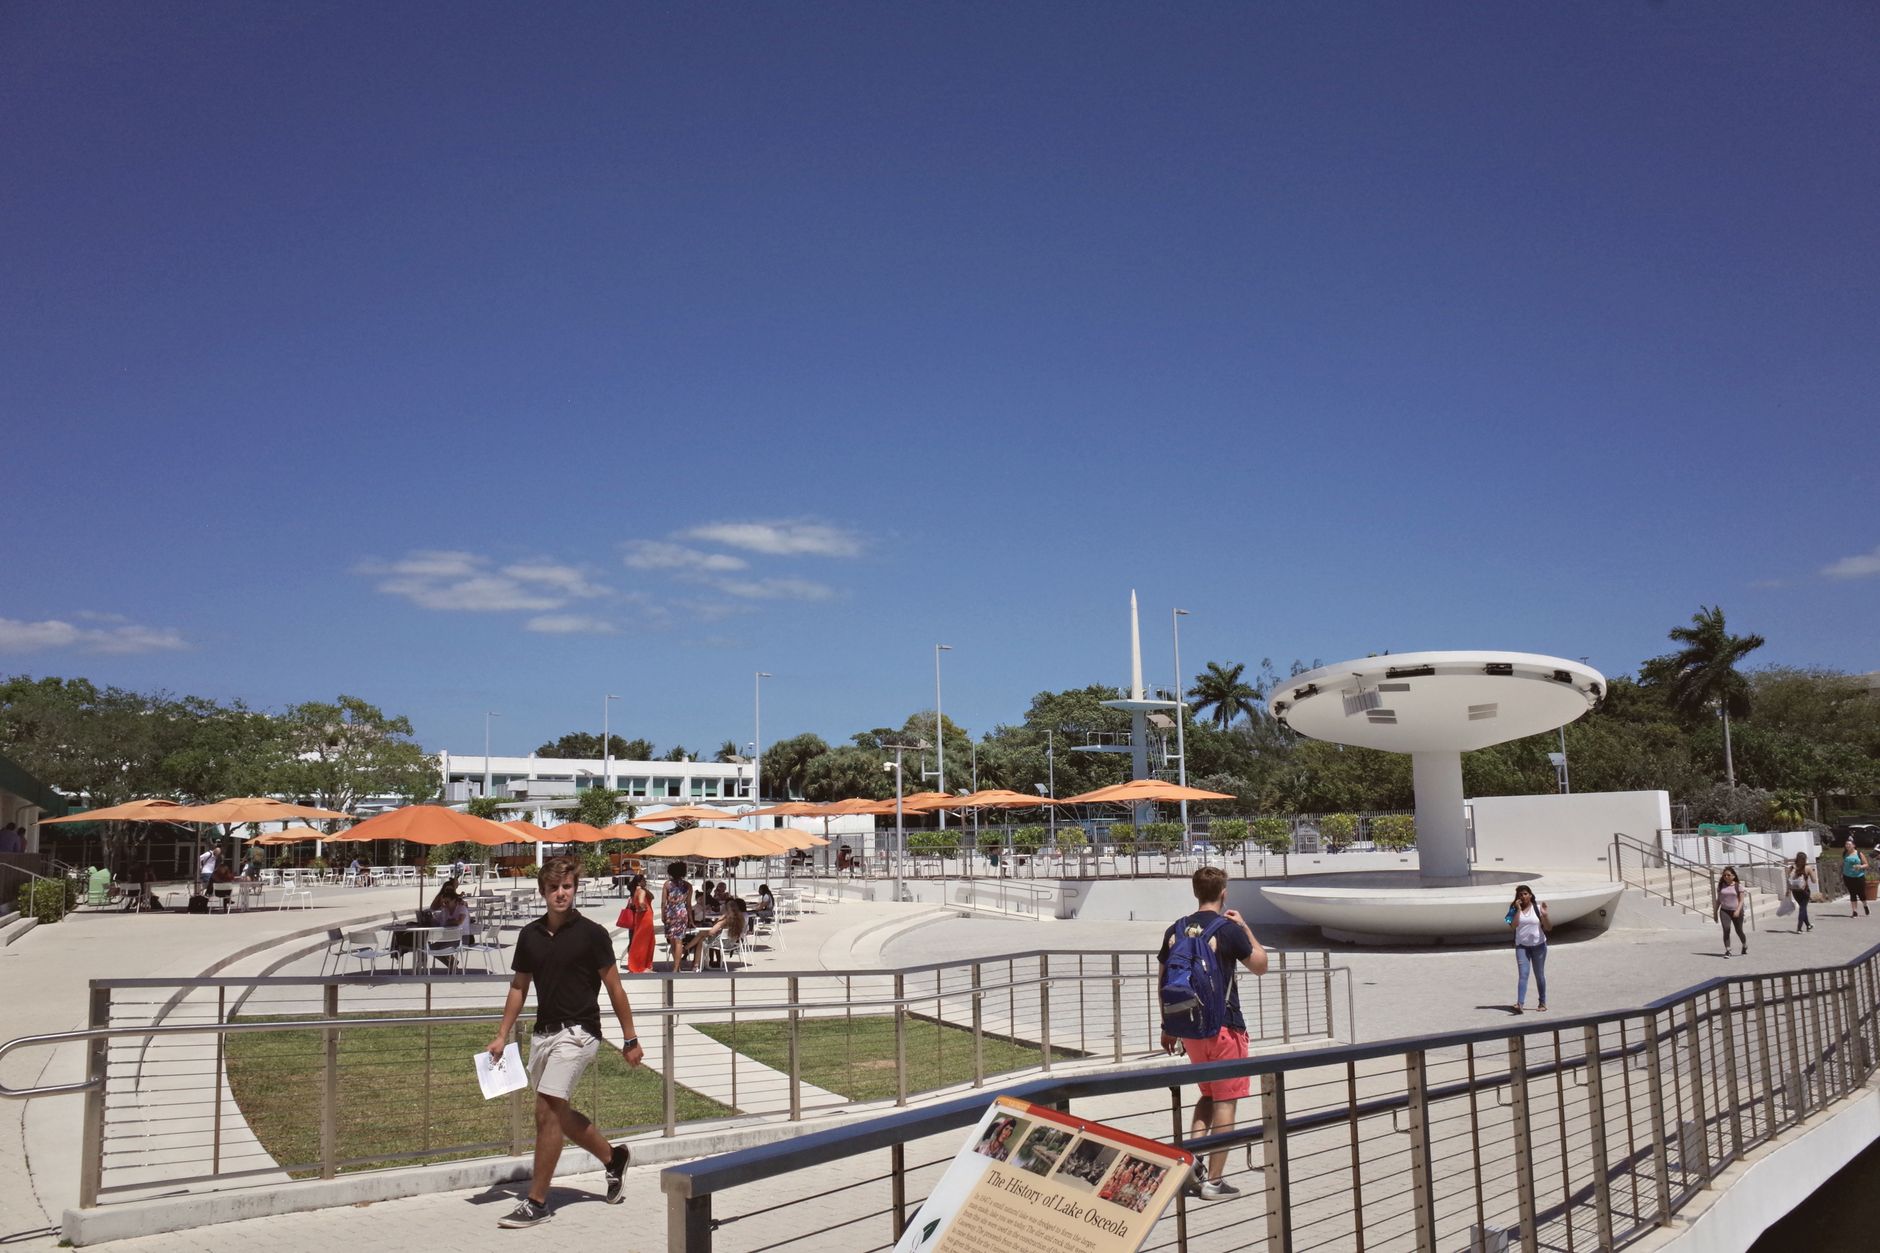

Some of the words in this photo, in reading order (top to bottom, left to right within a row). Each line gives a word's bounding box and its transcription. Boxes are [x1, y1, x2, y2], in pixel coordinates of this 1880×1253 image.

[987, 1170, 1005, 1188] The
[1005, 1178, 1043, 1204] History
[1043, 1194, 1059, 1207] of
[1054, 1196, 1083, 1218] Lake
[1084, 1209, 1128, 1238] Osceola
